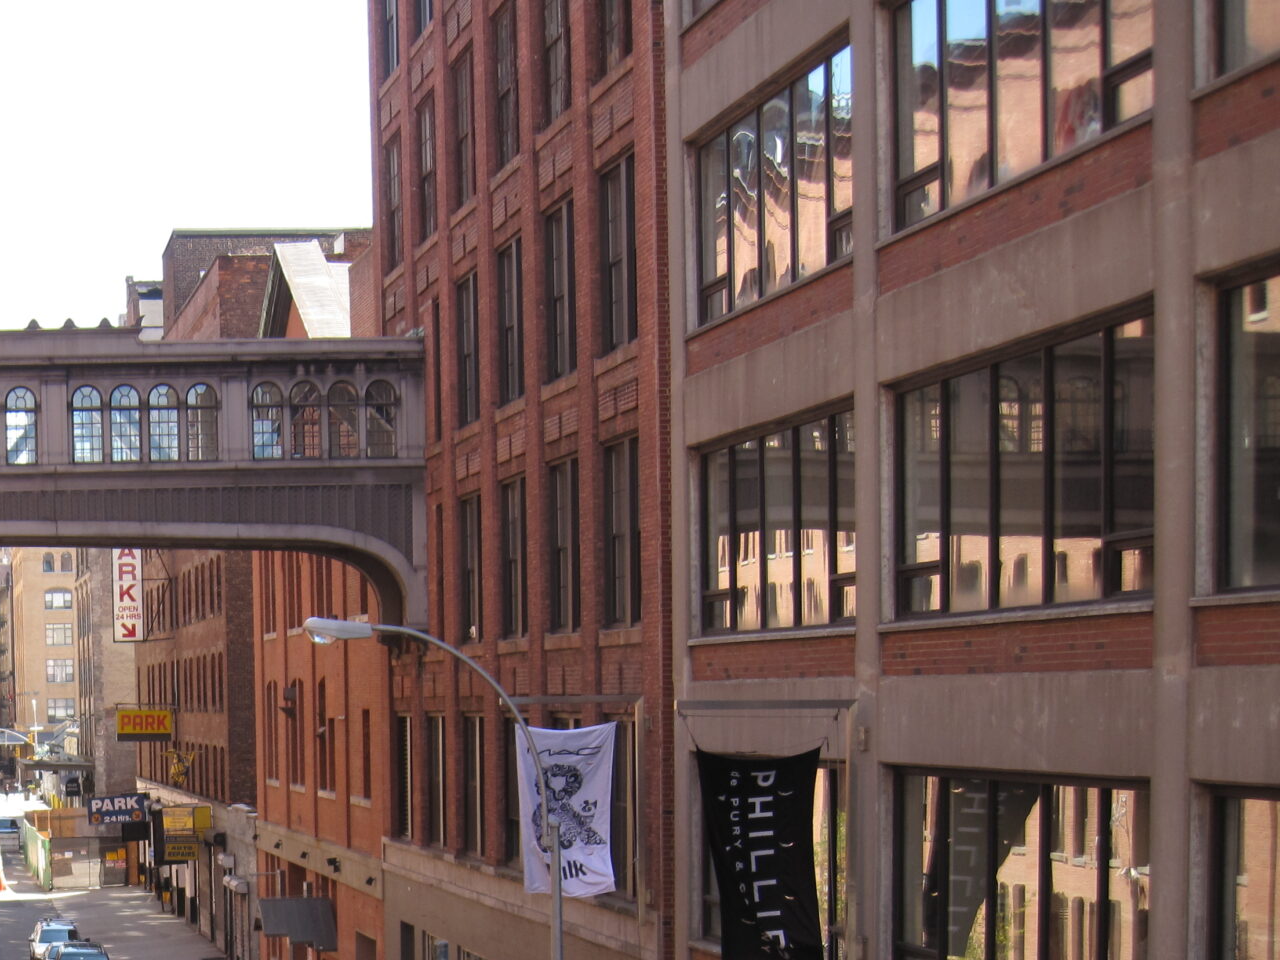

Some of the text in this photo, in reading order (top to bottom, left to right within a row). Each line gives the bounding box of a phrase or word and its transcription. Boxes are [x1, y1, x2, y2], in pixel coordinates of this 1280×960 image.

[117, 549, 137, 602] ARK
[116, 613, 141, 621] 24 HRS
[118, 605, 138, 613] OPEN
[120, 710, 168, 732] PARK
[730, 771, 740, 786] de
[91, 796, 139, 812] PARK
[103, 815, 116, 823] 24
[730, 797, 742, 848] PURY
[546, 860, 587, 880] ilk
[748, 770, 789, 960] PHILLIP
